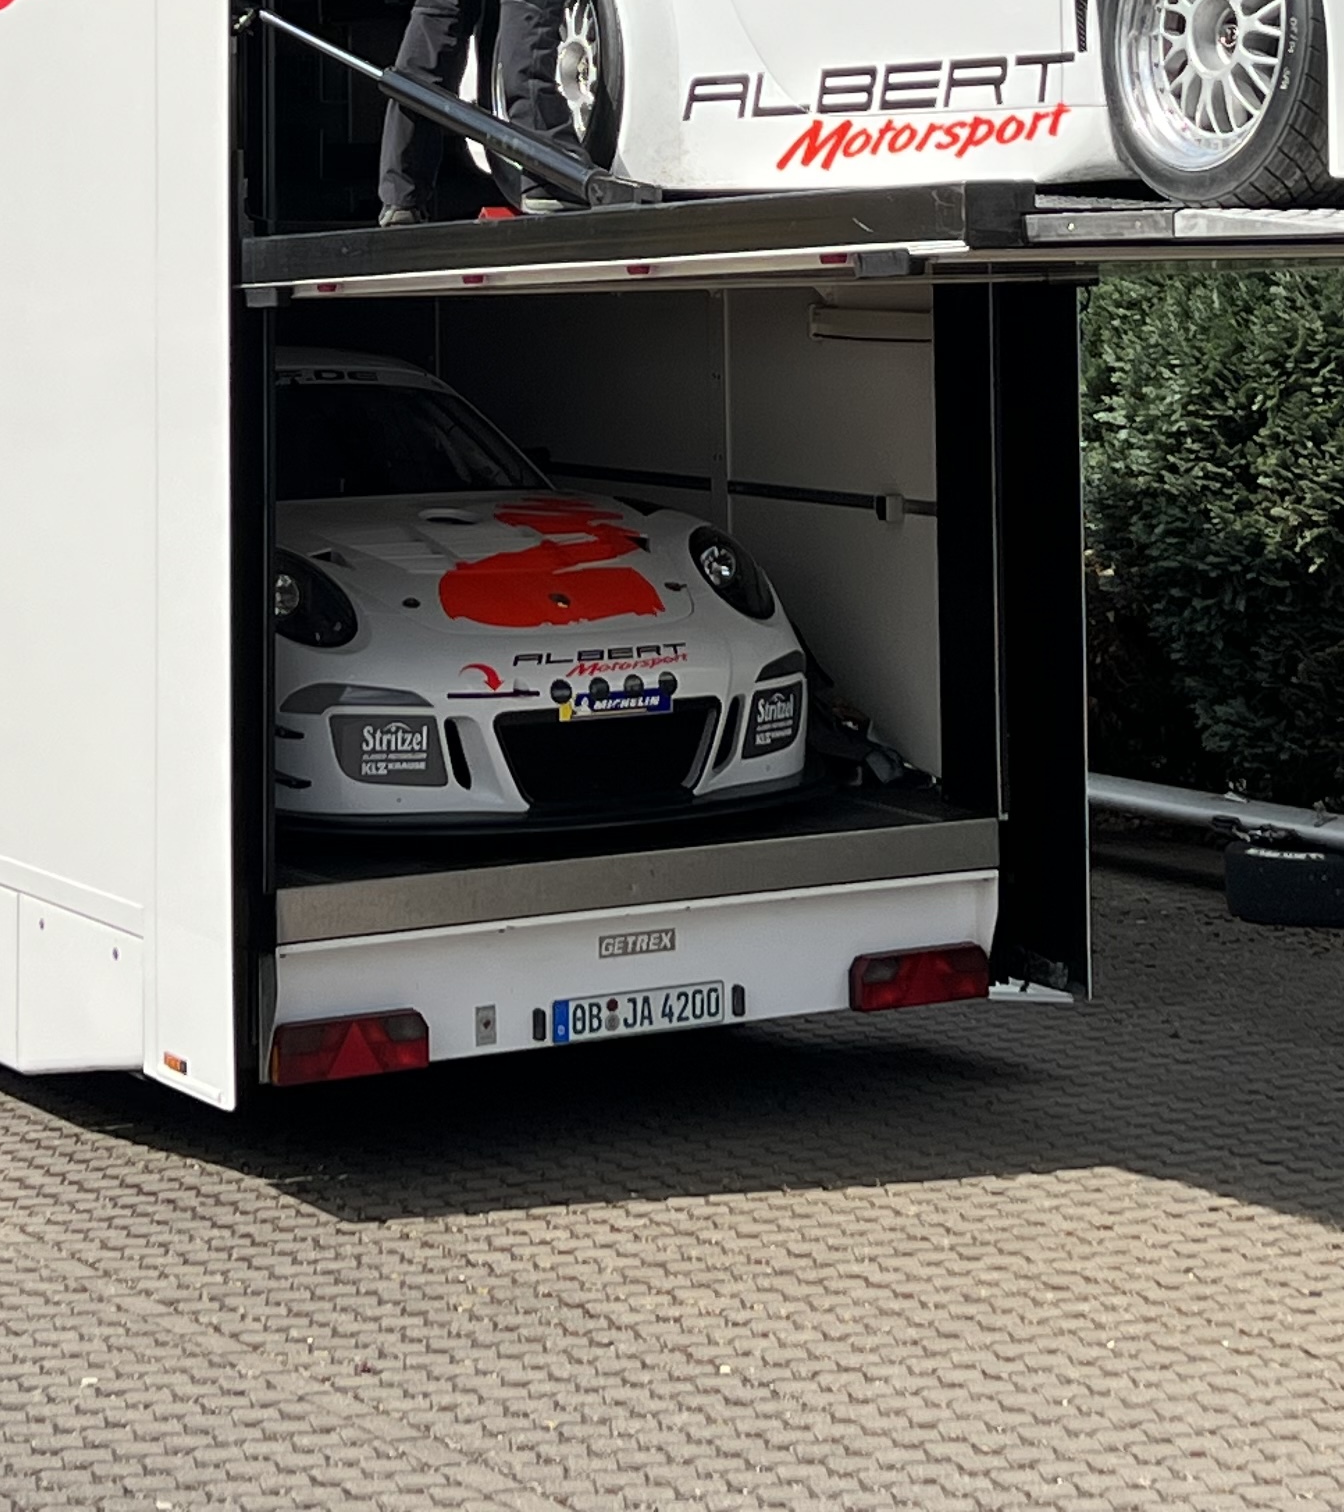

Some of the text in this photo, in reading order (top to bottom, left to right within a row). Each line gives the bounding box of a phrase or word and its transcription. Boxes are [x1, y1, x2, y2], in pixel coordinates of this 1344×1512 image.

[682, 51, 1075, 121] ALBERT
[777, 101, 1073, 171] Motorsport
[513, 642, 687, 667] ALBERT
[566, 653, 688, 678] Motorsport
[593, 695, 660, 710] MICHELIN
[362, 725, 428, 751] Stritzel
[601, 931, 673, 956] GETREX
[572, 987, 720, 1035] OB JA 4200
